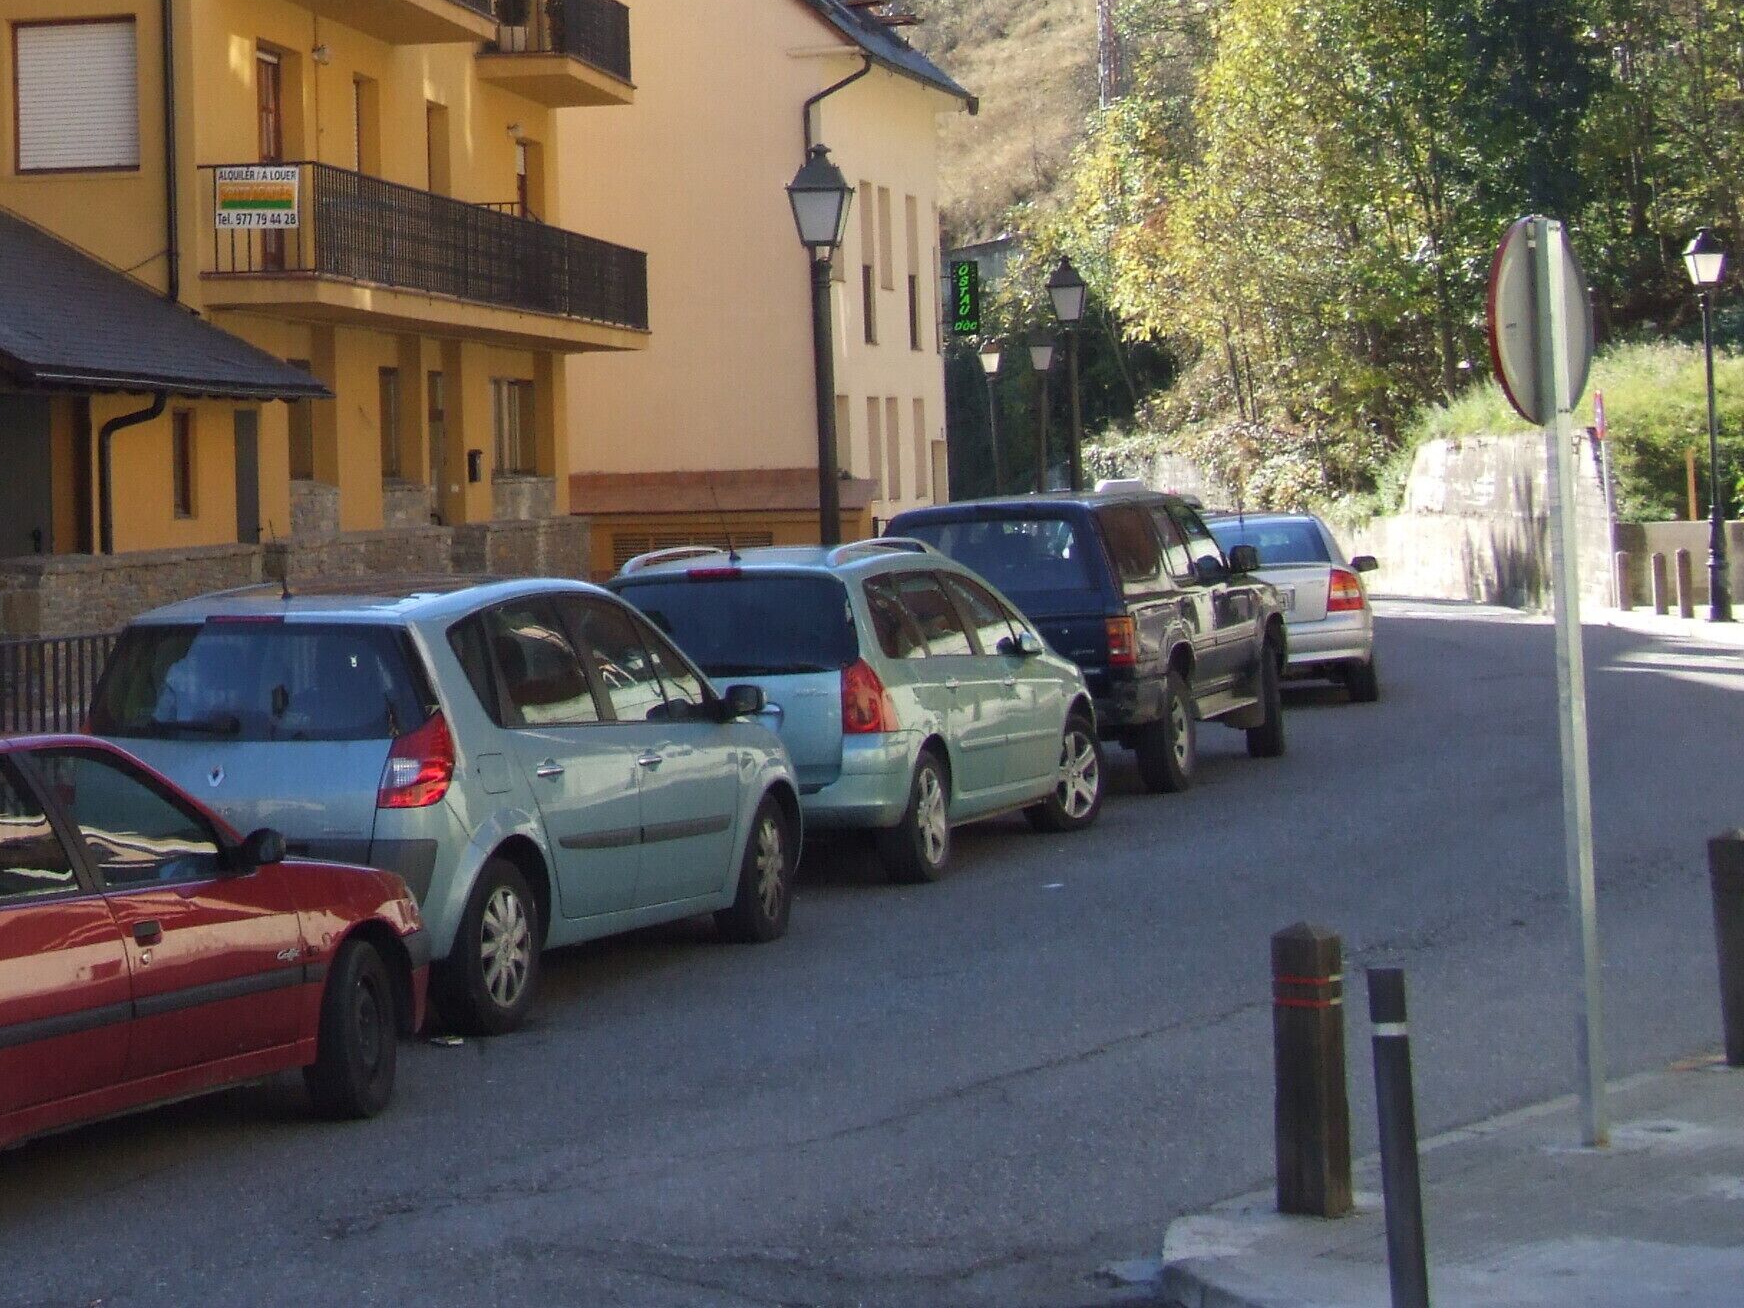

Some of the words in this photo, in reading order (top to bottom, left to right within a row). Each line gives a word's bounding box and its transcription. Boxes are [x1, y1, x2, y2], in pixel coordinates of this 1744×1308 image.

[270, 170, 297, 181] LOUER
[218, 213, 233, 225] Tel.
[236, 213, 253, 225] 977
[257, 213, 268, 225] 79
[271, 213, 282, 225] 44
[285, 213, 296, 225] 28
